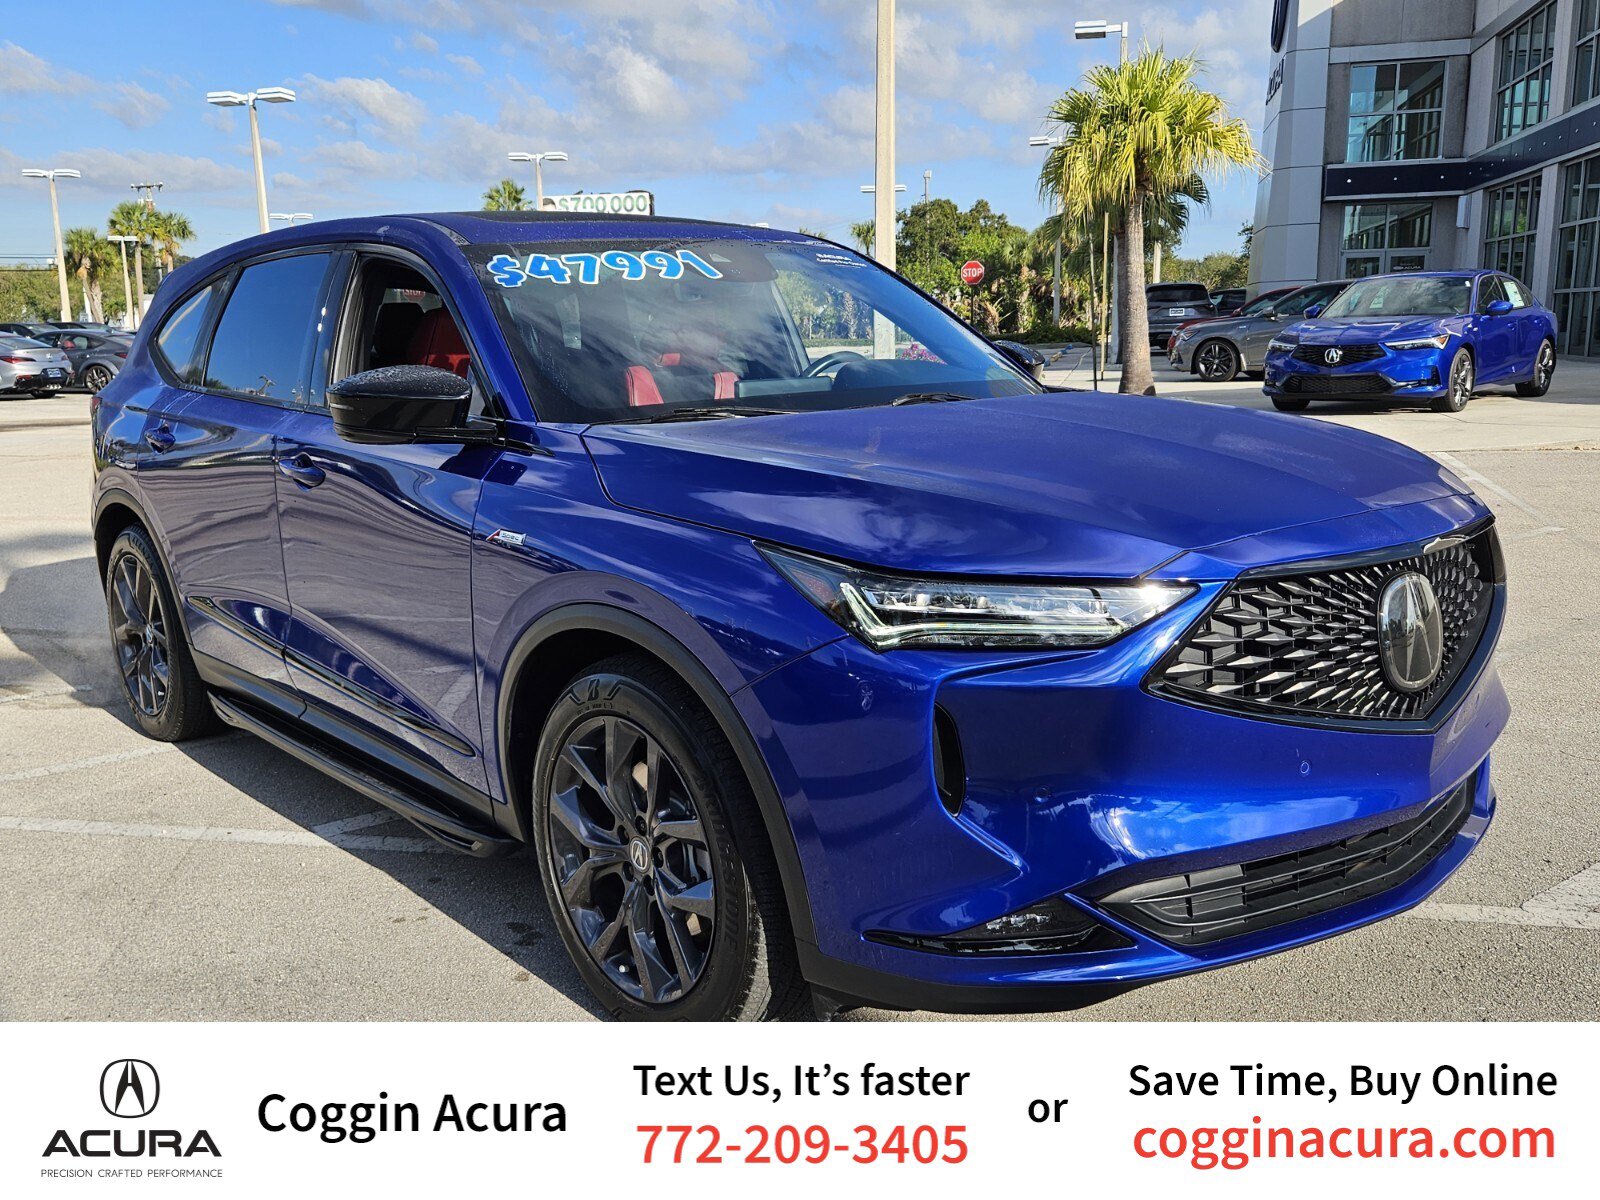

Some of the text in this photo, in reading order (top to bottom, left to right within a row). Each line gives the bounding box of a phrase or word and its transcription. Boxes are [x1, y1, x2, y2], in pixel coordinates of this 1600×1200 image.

[559, 194, 648, 213] $700000
[487, 250, 723, 287] $47991
[962, 267, 983, 278] STOP
